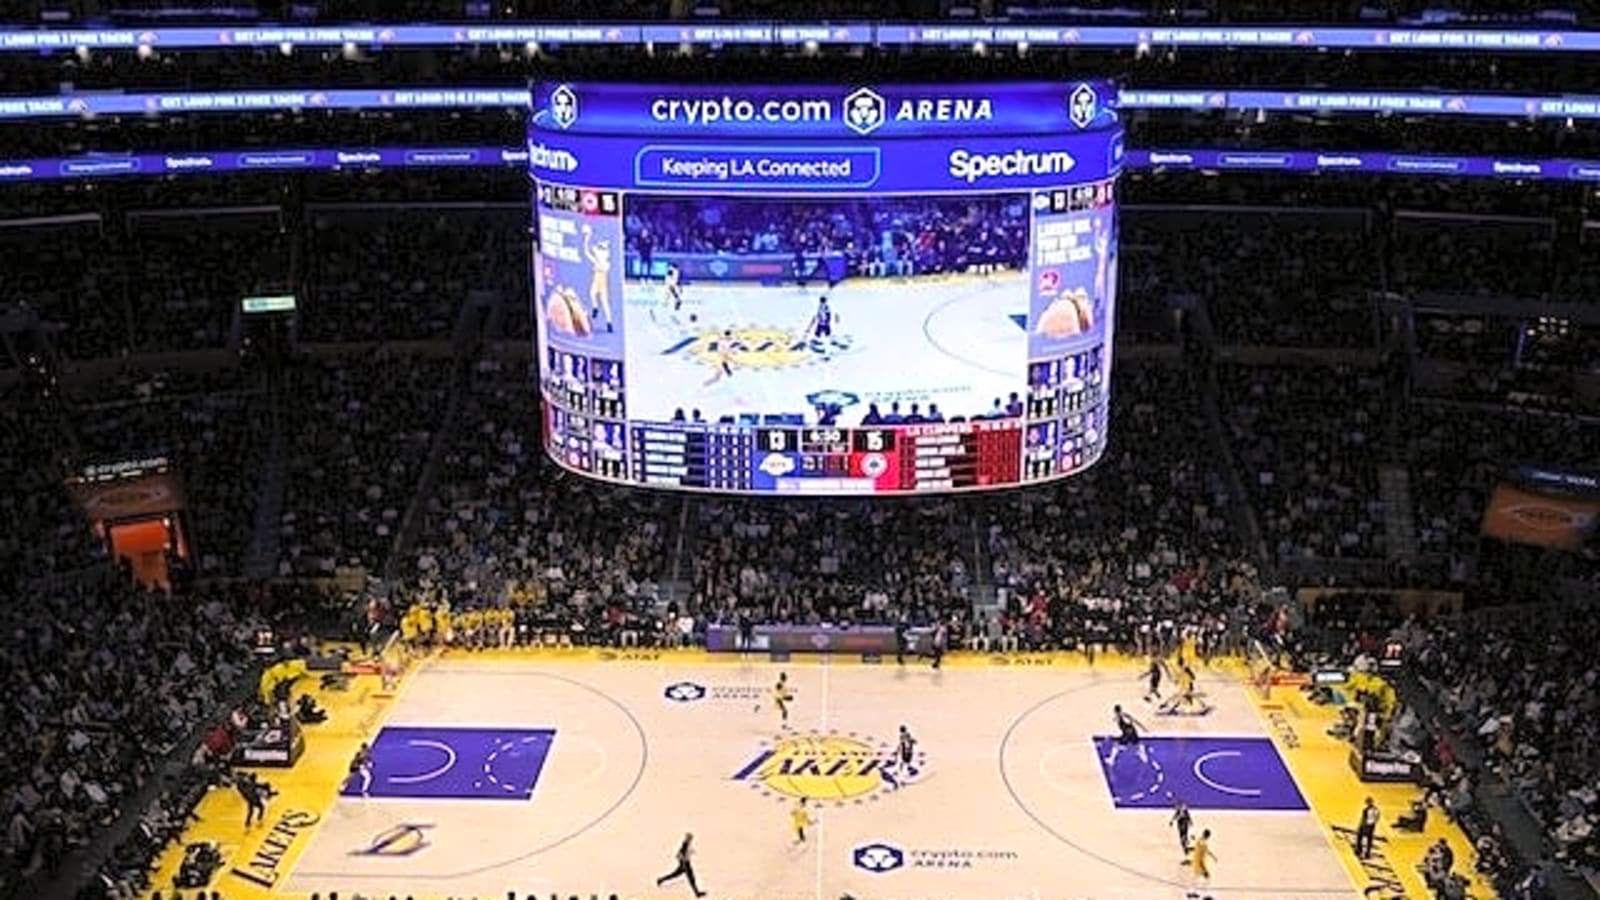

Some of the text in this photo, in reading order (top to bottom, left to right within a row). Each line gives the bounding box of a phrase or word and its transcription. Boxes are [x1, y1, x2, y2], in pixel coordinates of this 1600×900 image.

[651, 97, 993, 125] crypto.com ARENA
[662, 157, 852, 180] Keeping LA Connected
[949, 149, 1073, 184] Spectrum
[768, 430, 786, 451] 13
[866, 431, 884, 451] 15
[731, 750, 921, 791] LAKERS
[231, 810, 321, 889] LAKERS
